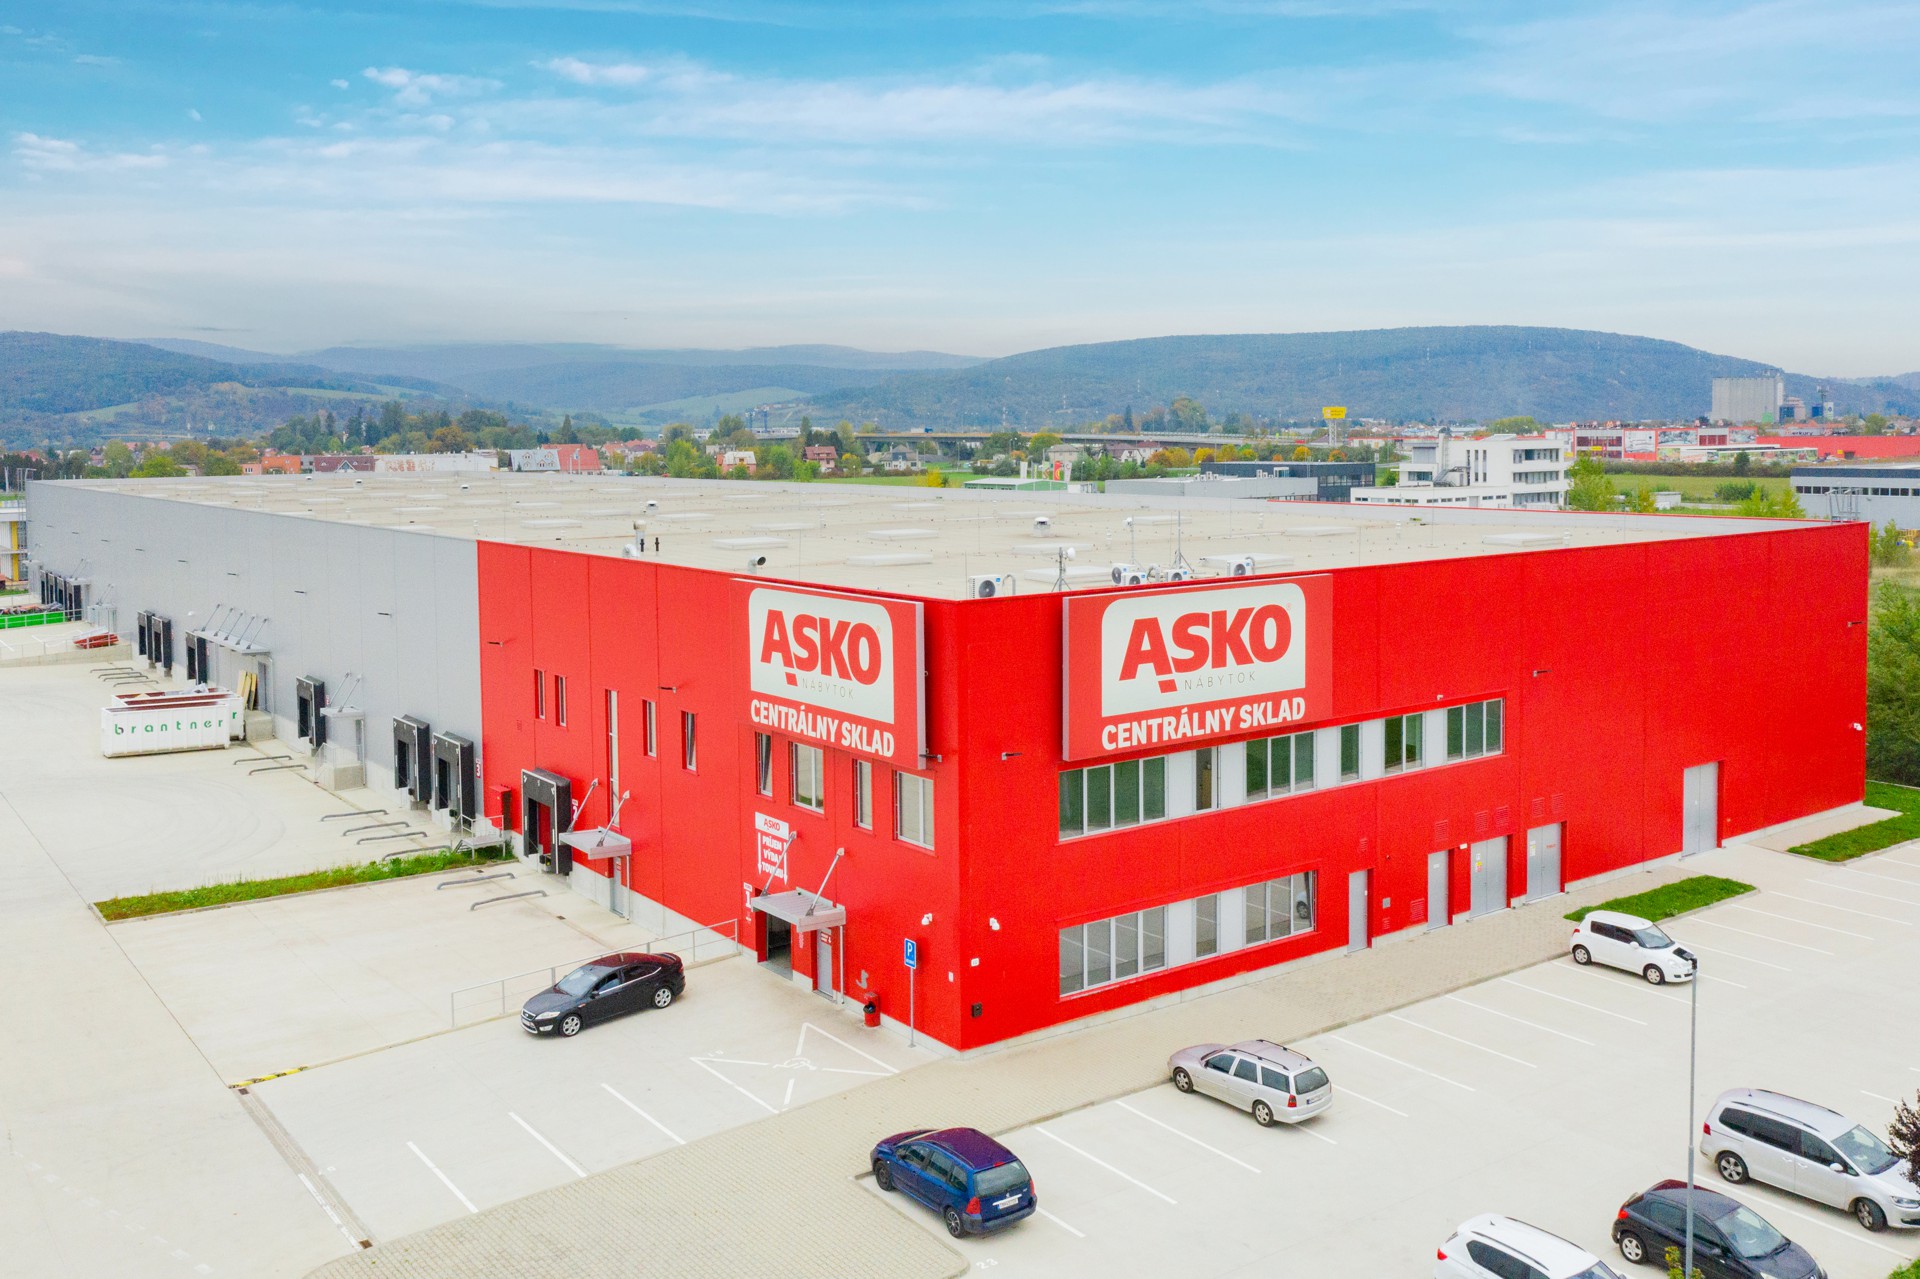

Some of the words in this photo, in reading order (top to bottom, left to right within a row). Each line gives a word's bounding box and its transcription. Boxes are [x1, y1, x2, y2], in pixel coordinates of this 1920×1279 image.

[761, 608, 882, 687] ASKO
[1118, 604, 1292, 694] ASKO
[114, 719, 223, 735] brantner
[751, 699, 839, 743] CENTRÁLNY
[841, 721, 895, 758] SKLAD
[1101, 706, 1236, 751] CENTRÁLNY
[1239, 696, 1306, 730] SKLAD
[763, 818, 780, 831] ASKO
[907, 942, 913, 957] P
